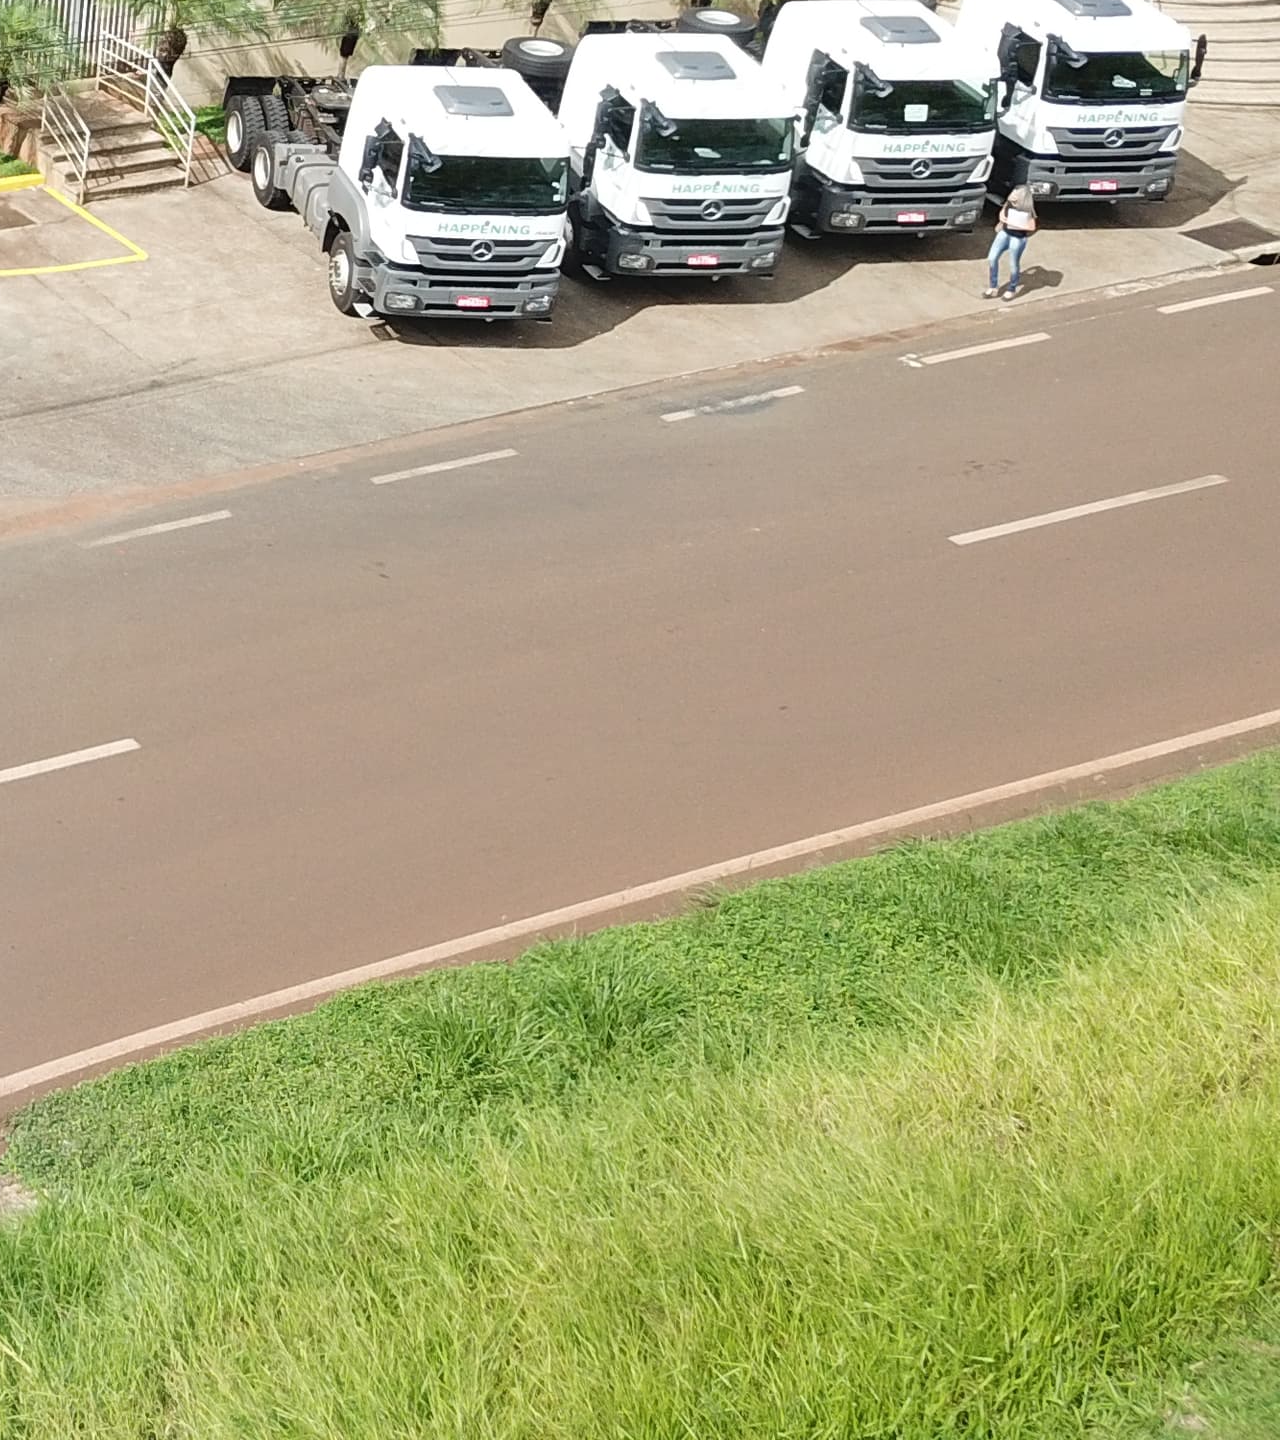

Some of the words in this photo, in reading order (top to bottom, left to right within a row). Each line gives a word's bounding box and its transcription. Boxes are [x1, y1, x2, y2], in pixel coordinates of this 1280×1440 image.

[1077, 111, 1159, 123] HAPPENING
[883, 142, 966, 153] HAPPENING
[672, 183, 761, 194] HAPPENING
[438, 223, 531, 236] HAPPENING
